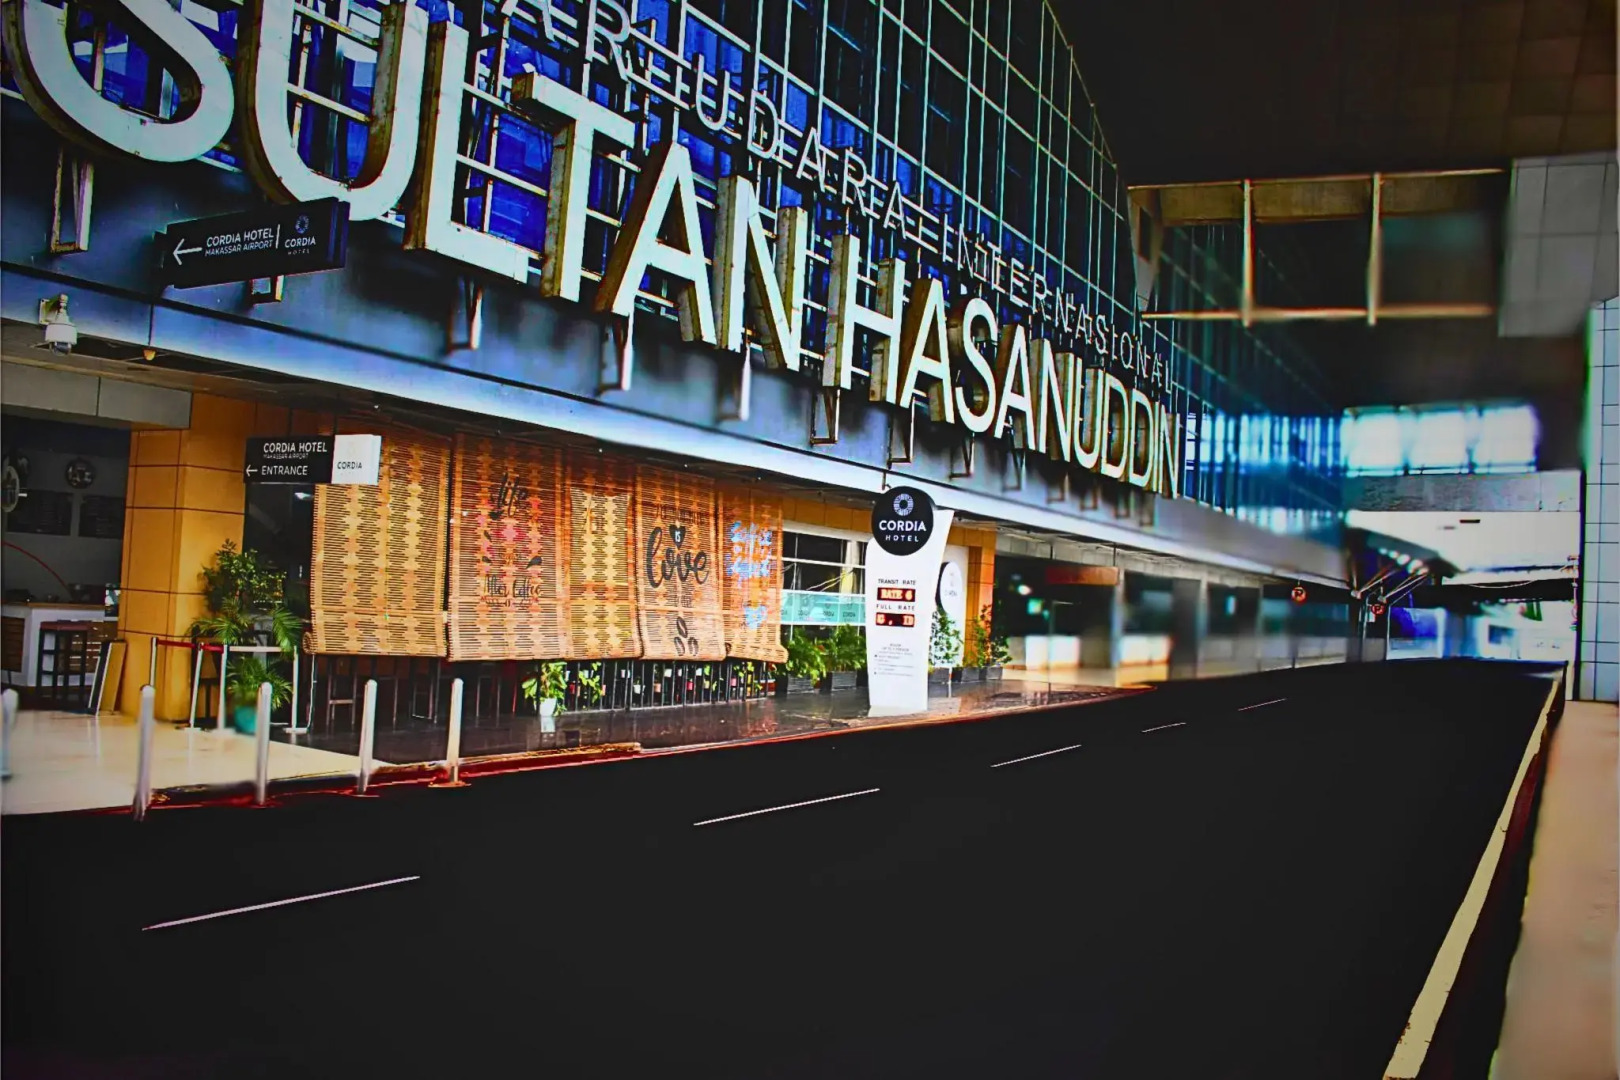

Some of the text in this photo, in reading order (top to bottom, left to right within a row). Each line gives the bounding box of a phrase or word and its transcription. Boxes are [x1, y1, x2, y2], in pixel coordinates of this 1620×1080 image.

[695, 53, 907, 239] UDARA
[943, 213, 1173, 394] INTERNASIONAL
[206, 228, 274, 247] CORDIA HOTEL
[284, 235, 316, 249] CORDIA
[205, 240, 273, 257] MAKASSAR AIRPORT
[838, 233, 1181, 499] HASANUDDIN
[263, 442, 327, 454] CORDIA HOTEL
[261, 464, 309, 476] ENTRANCE
[336, 461, 363, 470] CORDIA
[878, 519, 927, 532] CORDIA
[885, 534, 920, 543] HOTEL
[646, 527, 709, 588] love
